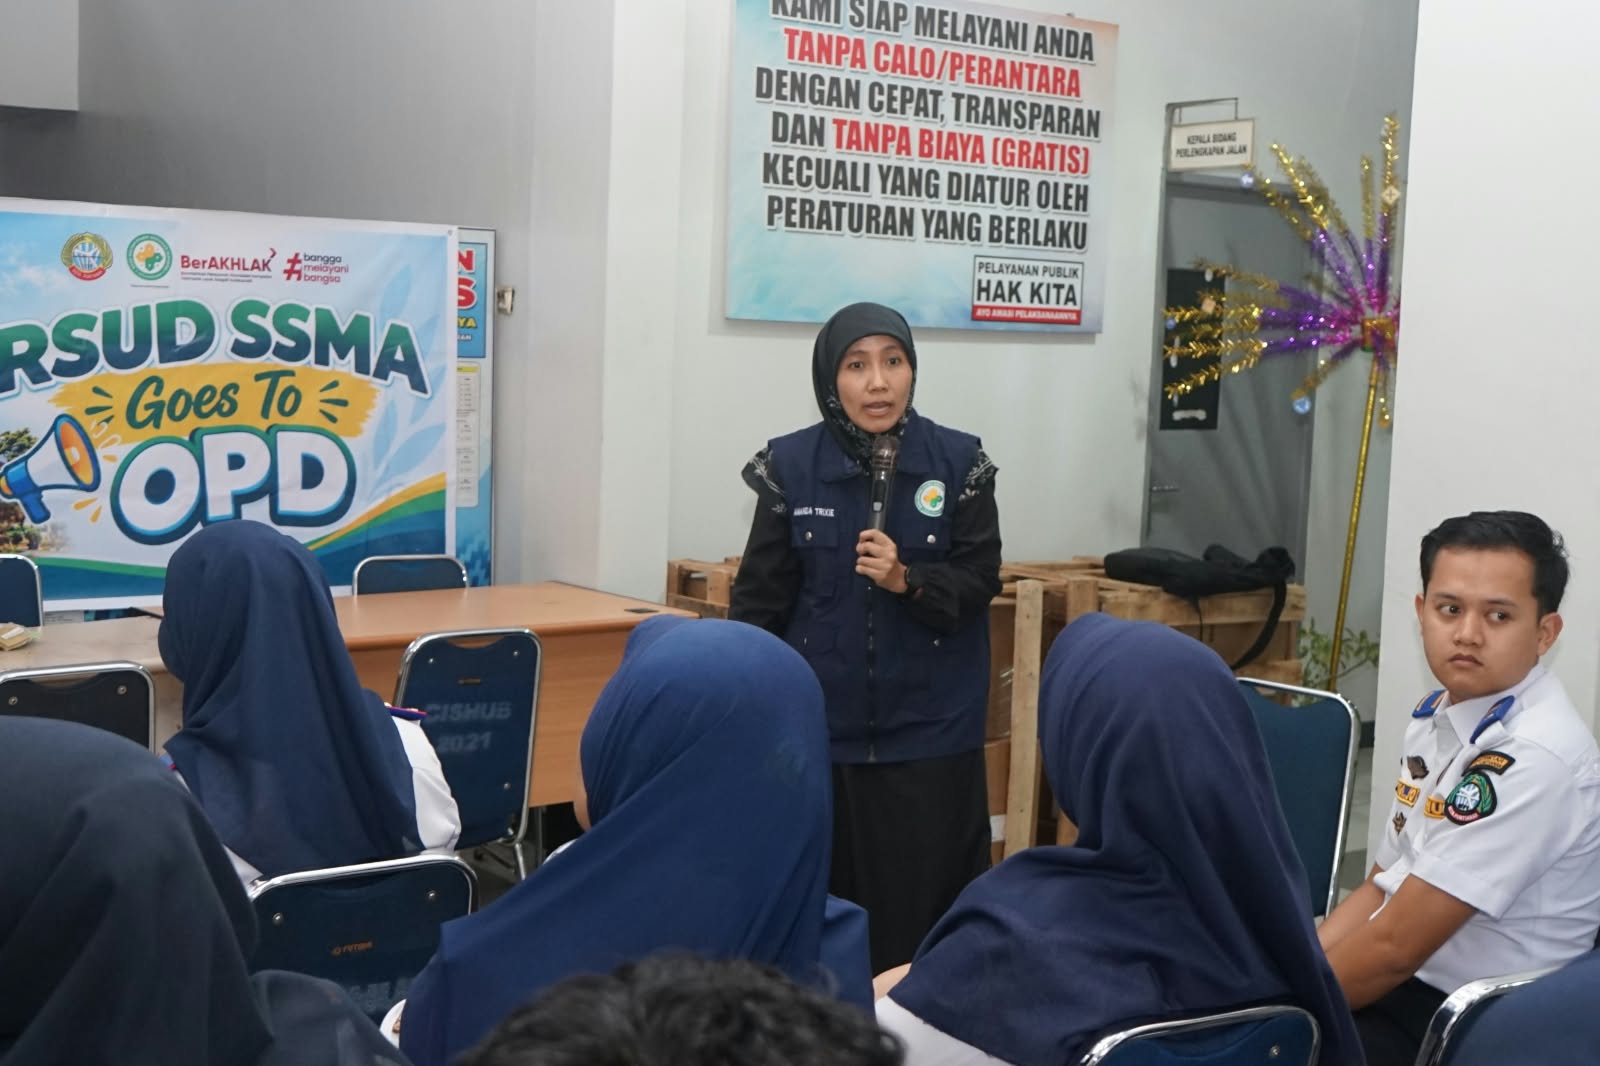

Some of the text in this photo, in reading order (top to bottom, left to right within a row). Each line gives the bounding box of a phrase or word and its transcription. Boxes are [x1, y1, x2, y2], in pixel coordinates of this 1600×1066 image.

[771, 0, 1094, 61] KAMI SIAP MELAYANI ANDA
[784, 28, 1081, 97] TANPA CALO/PERANTARA
[755, 67, 1100, 138] DENGAN CEPAT, TRANSPARAN
[771, 111, 1090, 175] DAN TANPA BIAYA (GRATIS)
[762, 152, 1089, 213] KECUALI YANG DIATUR OLEH
[767, 196, 1088, 250] PERATURAN YANG BERLAKU
[180, 255, 272, 272] BerAKHLAK
[303, 253, 342, 264] bangga
[303, 264, 349, 274] melayani
[303, 274, 341, 285] bangsa
[978, 262, 1079, 278] PELAYANAN PUBLIK
[976, 279, 1077, 306] HAK KITA
[0, 300, 429, 395] RSUD SSMA
[125, 370, 302, 429] Goes To
[111, 425, 357, 546] OPD
